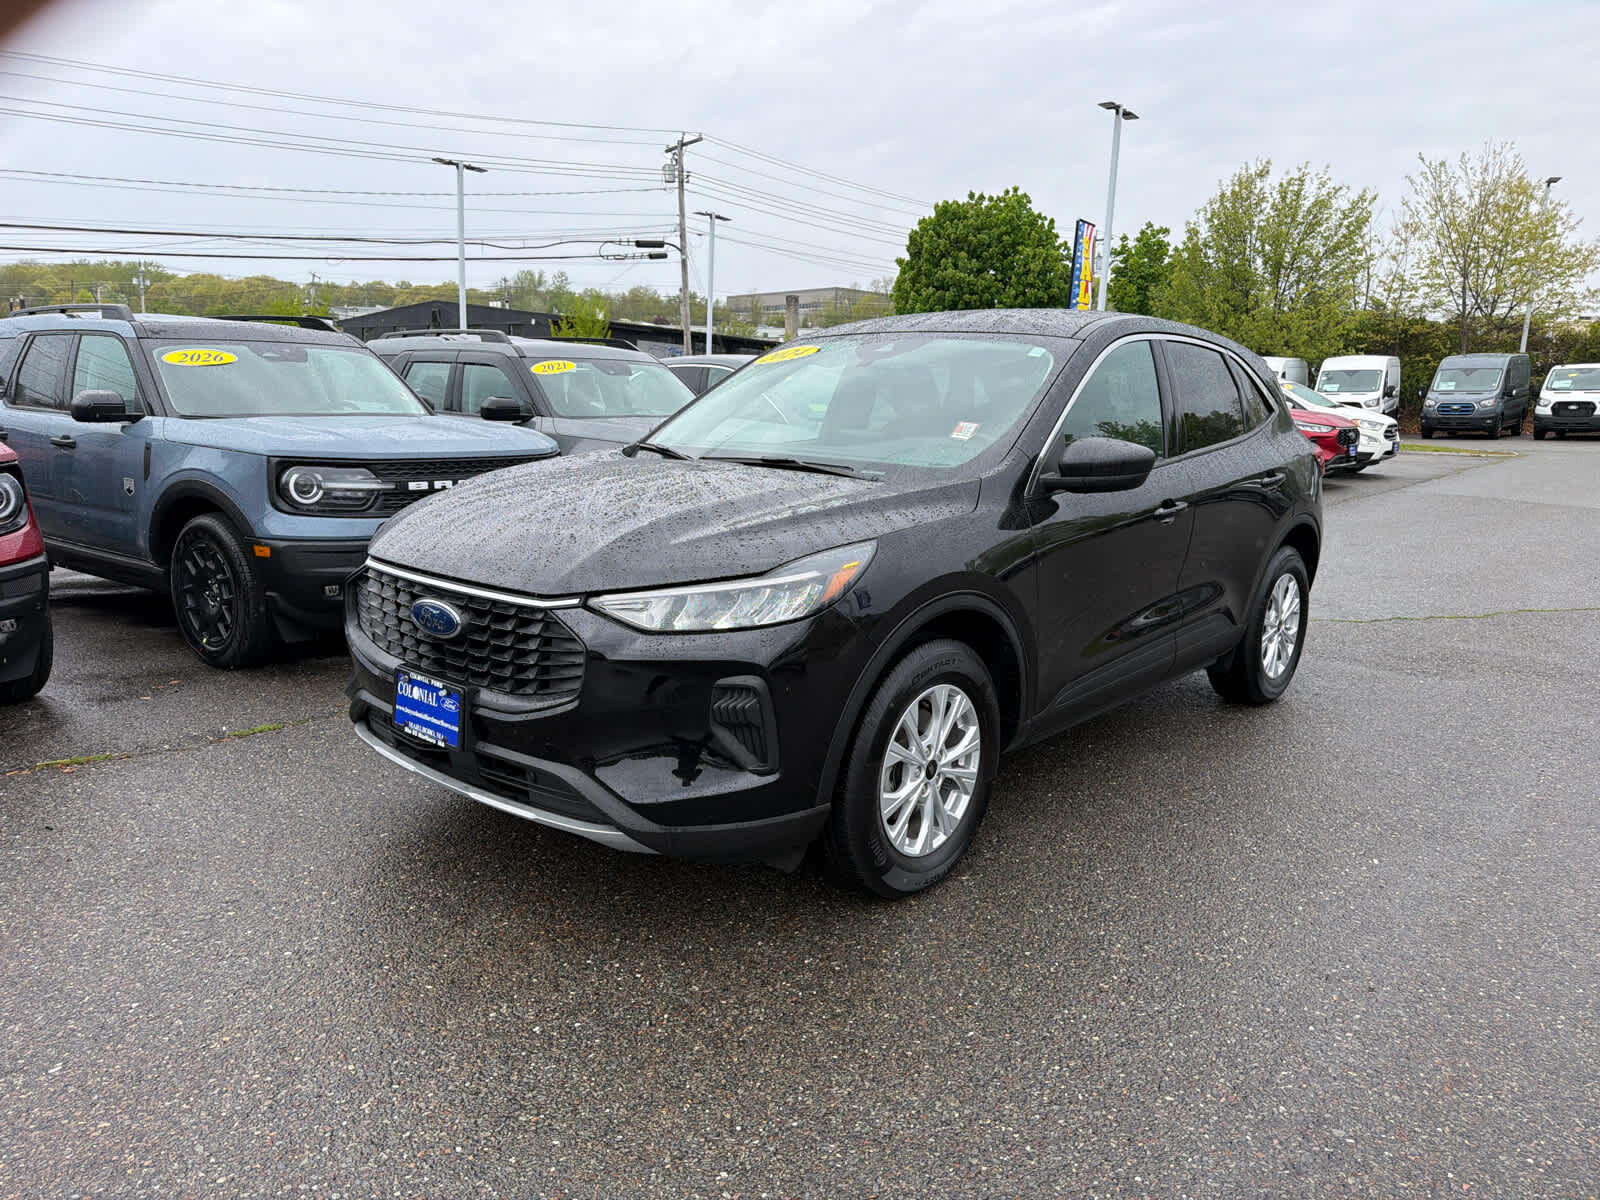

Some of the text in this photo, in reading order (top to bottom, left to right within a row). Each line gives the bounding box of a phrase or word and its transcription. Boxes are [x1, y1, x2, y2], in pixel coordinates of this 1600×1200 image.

[177, 352, 224, 363] 2026
[541, 362, 568, 373] 2021
[397, 680, 438, 707] COLONIAL
